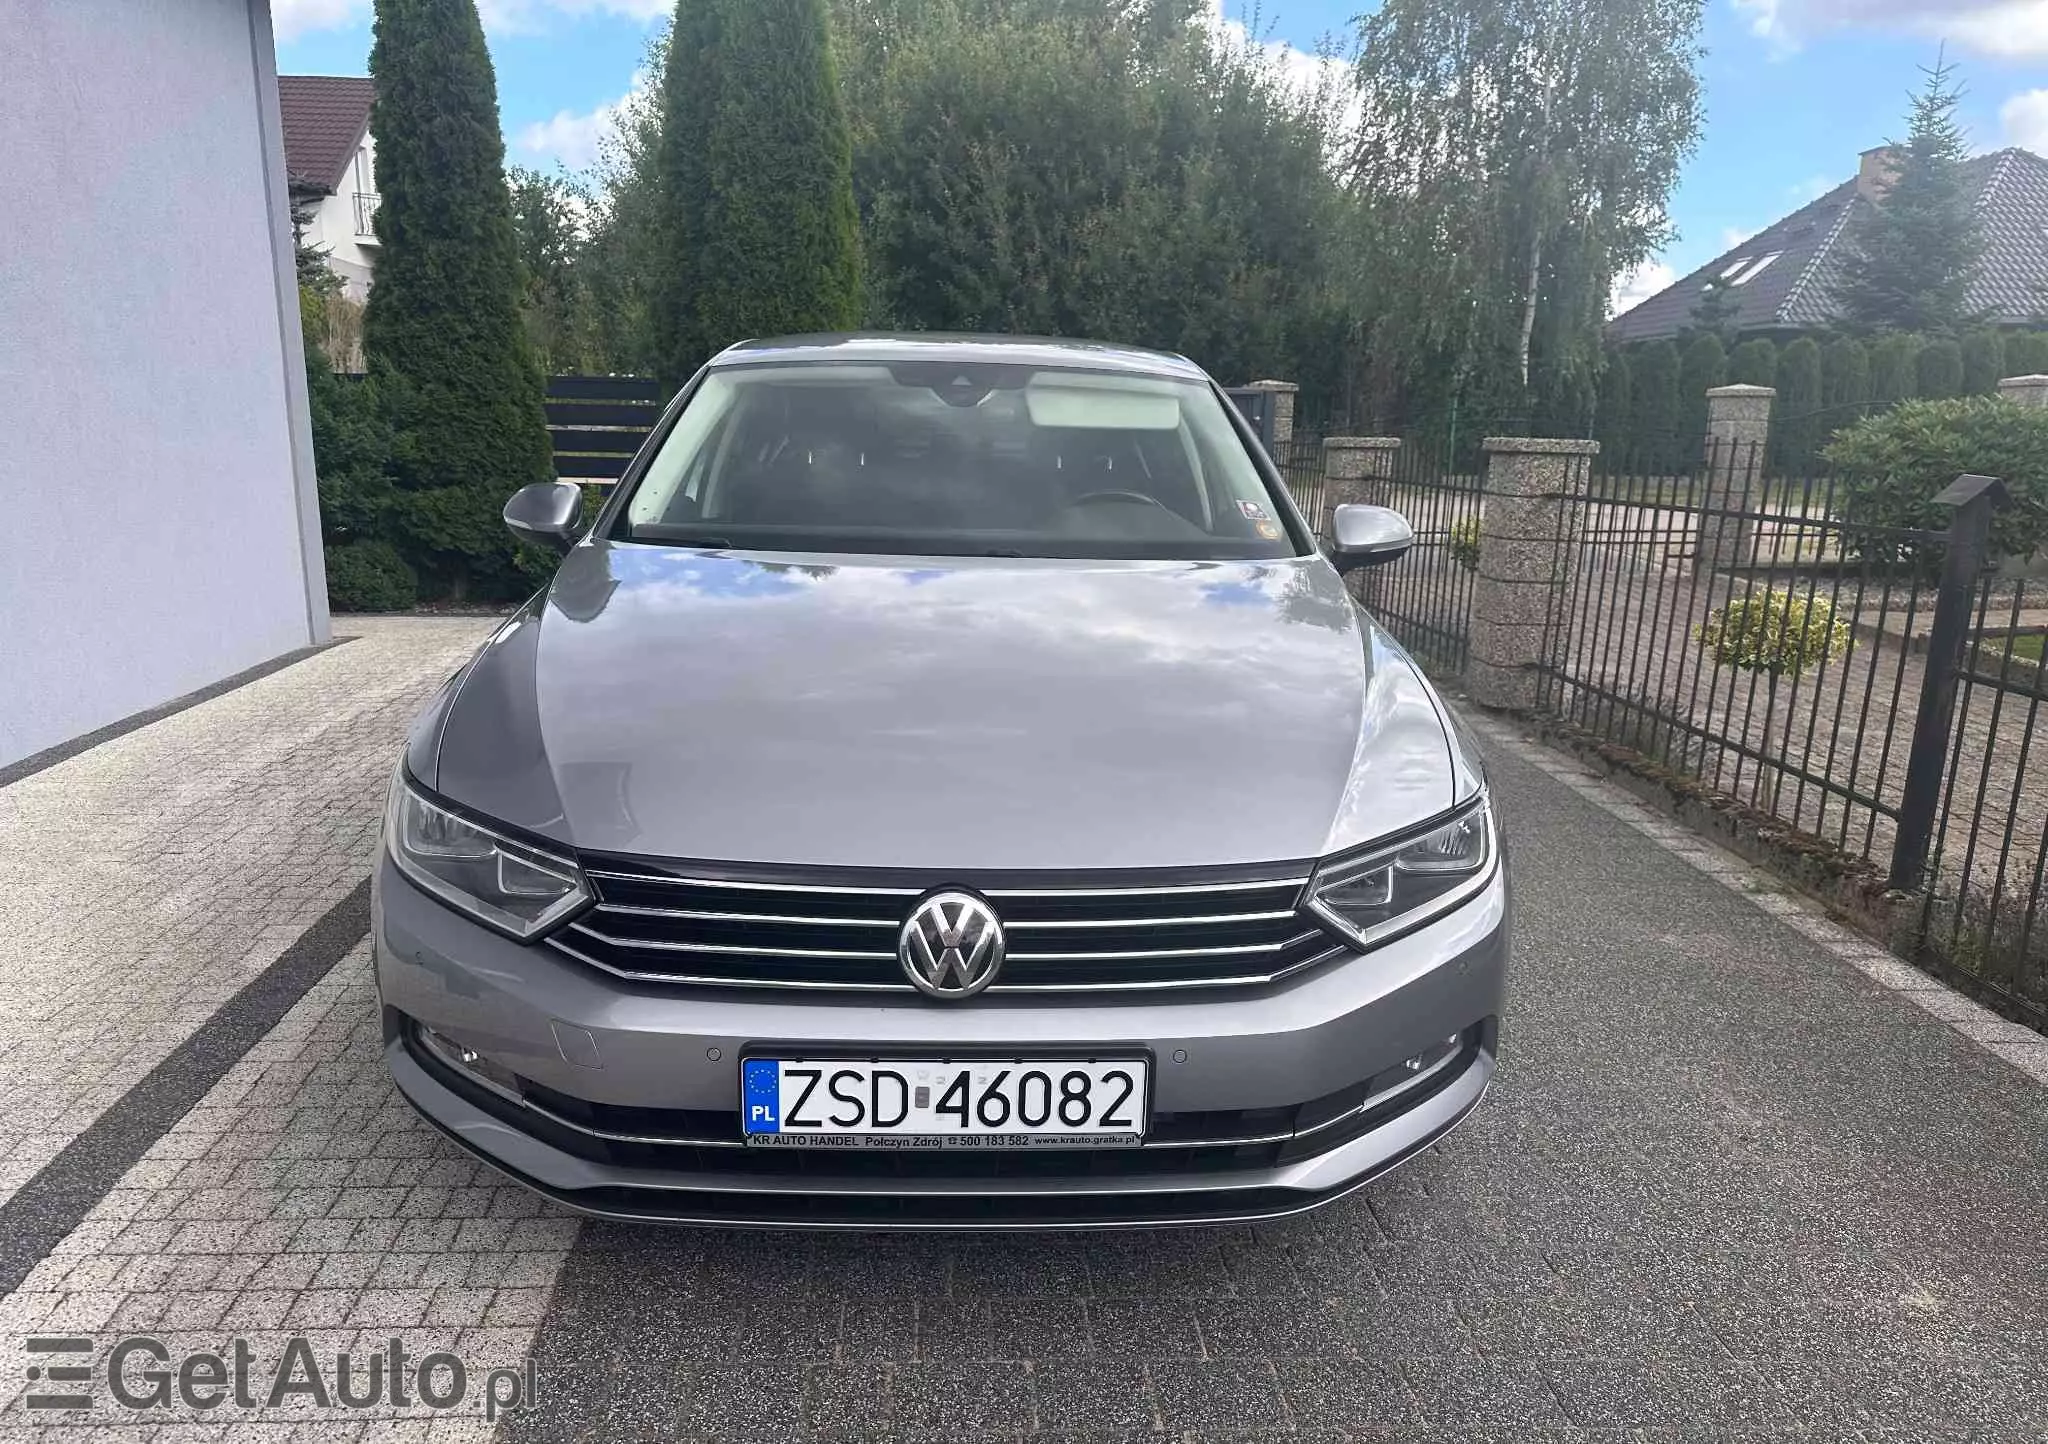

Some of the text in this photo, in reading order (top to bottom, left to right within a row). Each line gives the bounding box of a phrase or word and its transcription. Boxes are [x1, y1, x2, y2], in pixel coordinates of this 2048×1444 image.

[901, 895, 1003, 996] VW
[751, 1105, 775, 1122] PL
[784, 1069, 1134, 1128] ZSD 46082
[753, 1135, 770, 1146] KR
[774, 1135, 807, 1146] AUTO
[810, 1136, 859, 1147] HANDEL
[912, 1136, 944, 1150] Zdrój
[959, 1136, 981, 1147] 500
[986, 1136, 1005, 1147] 183
[1008, 1136, 1030, 1147] 582
